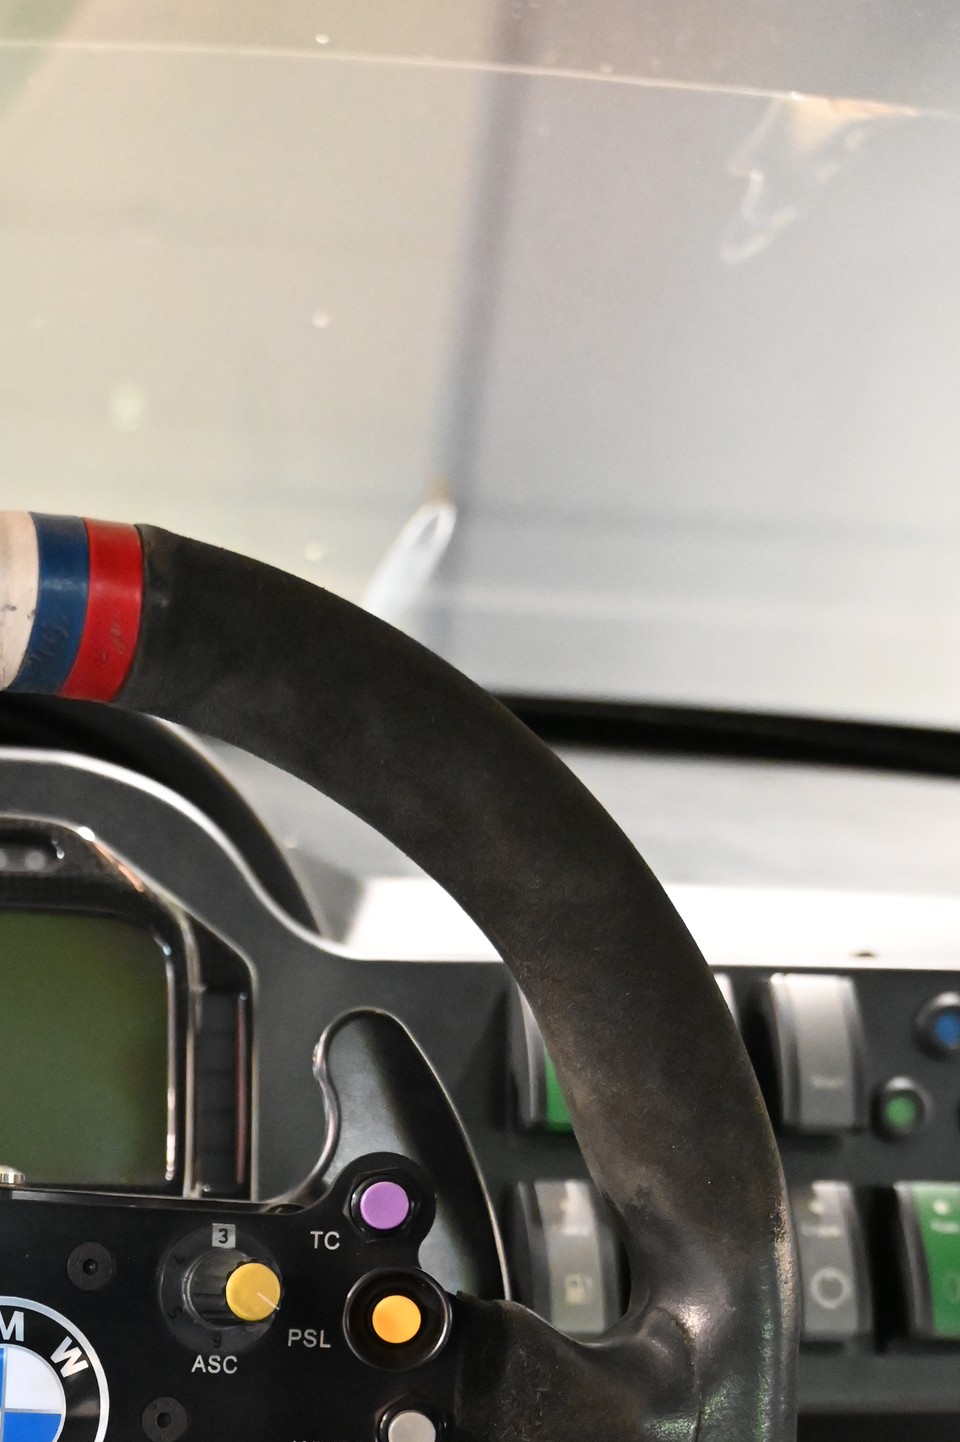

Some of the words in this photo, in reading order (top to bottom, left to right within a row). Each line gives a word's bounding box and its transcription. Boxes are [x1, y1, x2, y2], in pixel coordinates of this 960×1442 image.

[218, 1228, 228, 1244] 3
[309, 1230, 340, 1251] TC
[287, 1328, 331, 1349] PSL
[191, 1354, 238, 1374] ASC
